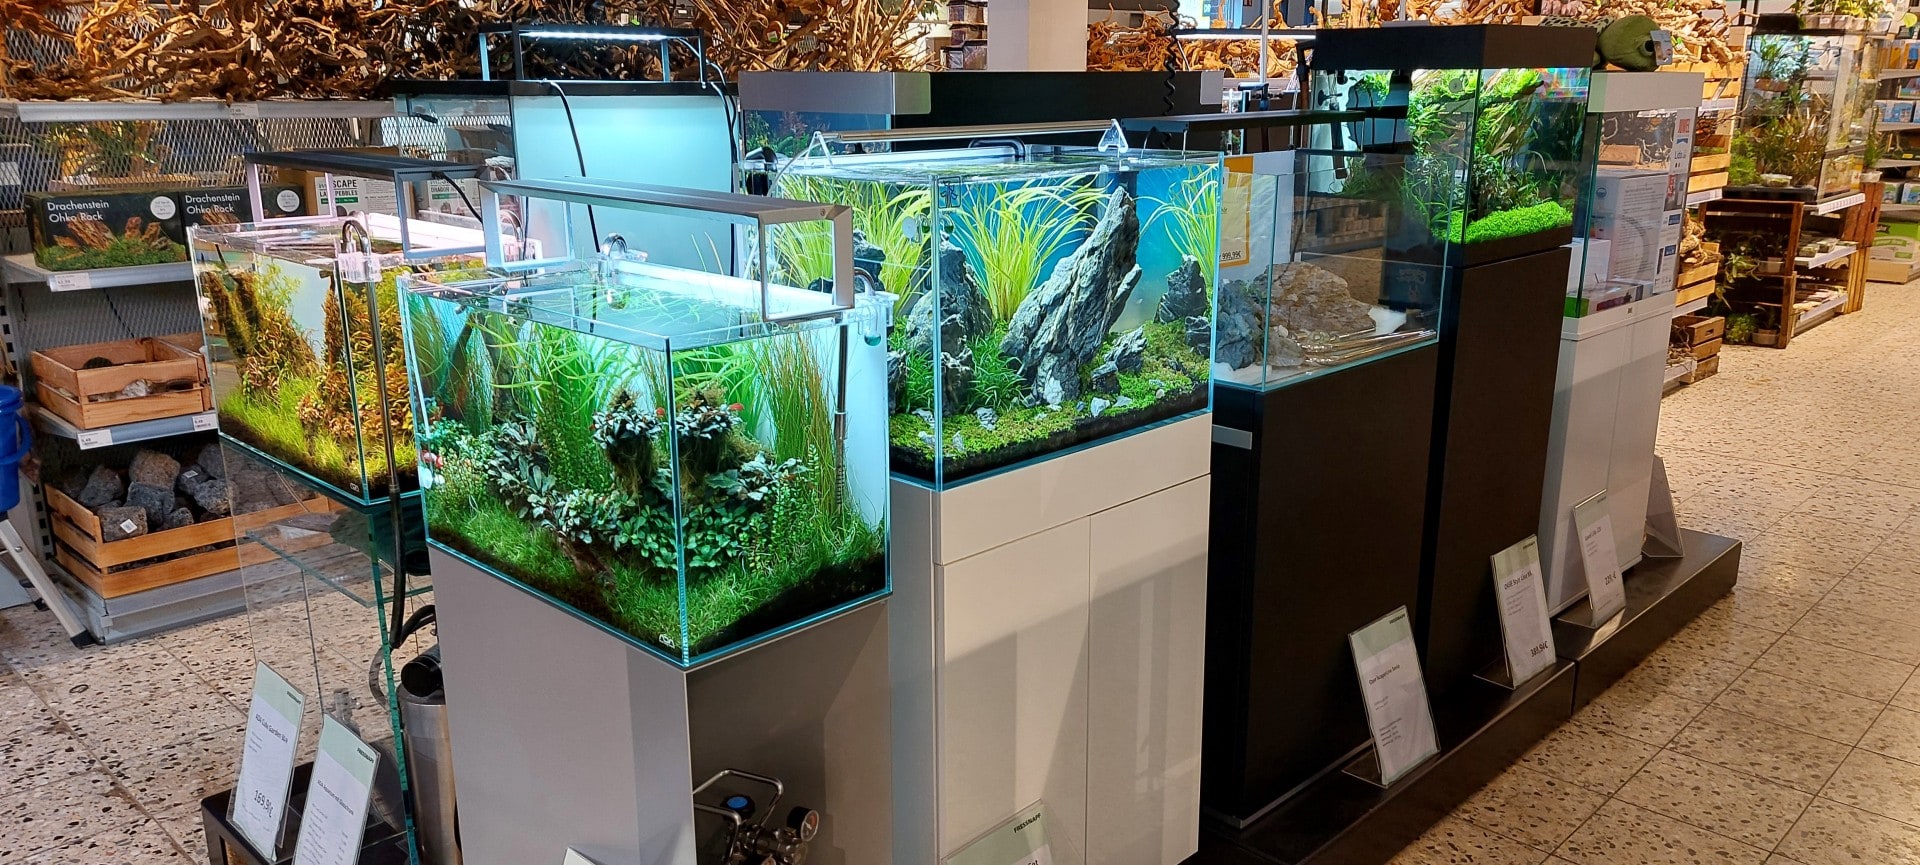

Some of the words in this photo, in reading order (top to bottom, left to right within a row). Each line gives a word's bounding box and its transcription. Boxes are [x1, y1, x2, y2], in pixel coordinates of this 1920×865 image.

[185, 193, 240, 203] Drachenstein
[47, 200, 109, 211] Drachenstein
[187, 204, 212, 215] Ohko
[214, 203, 234, 213] Rack
[49, 212, 77, 223] Ohko
[80, 211, 103, 221] Rack
